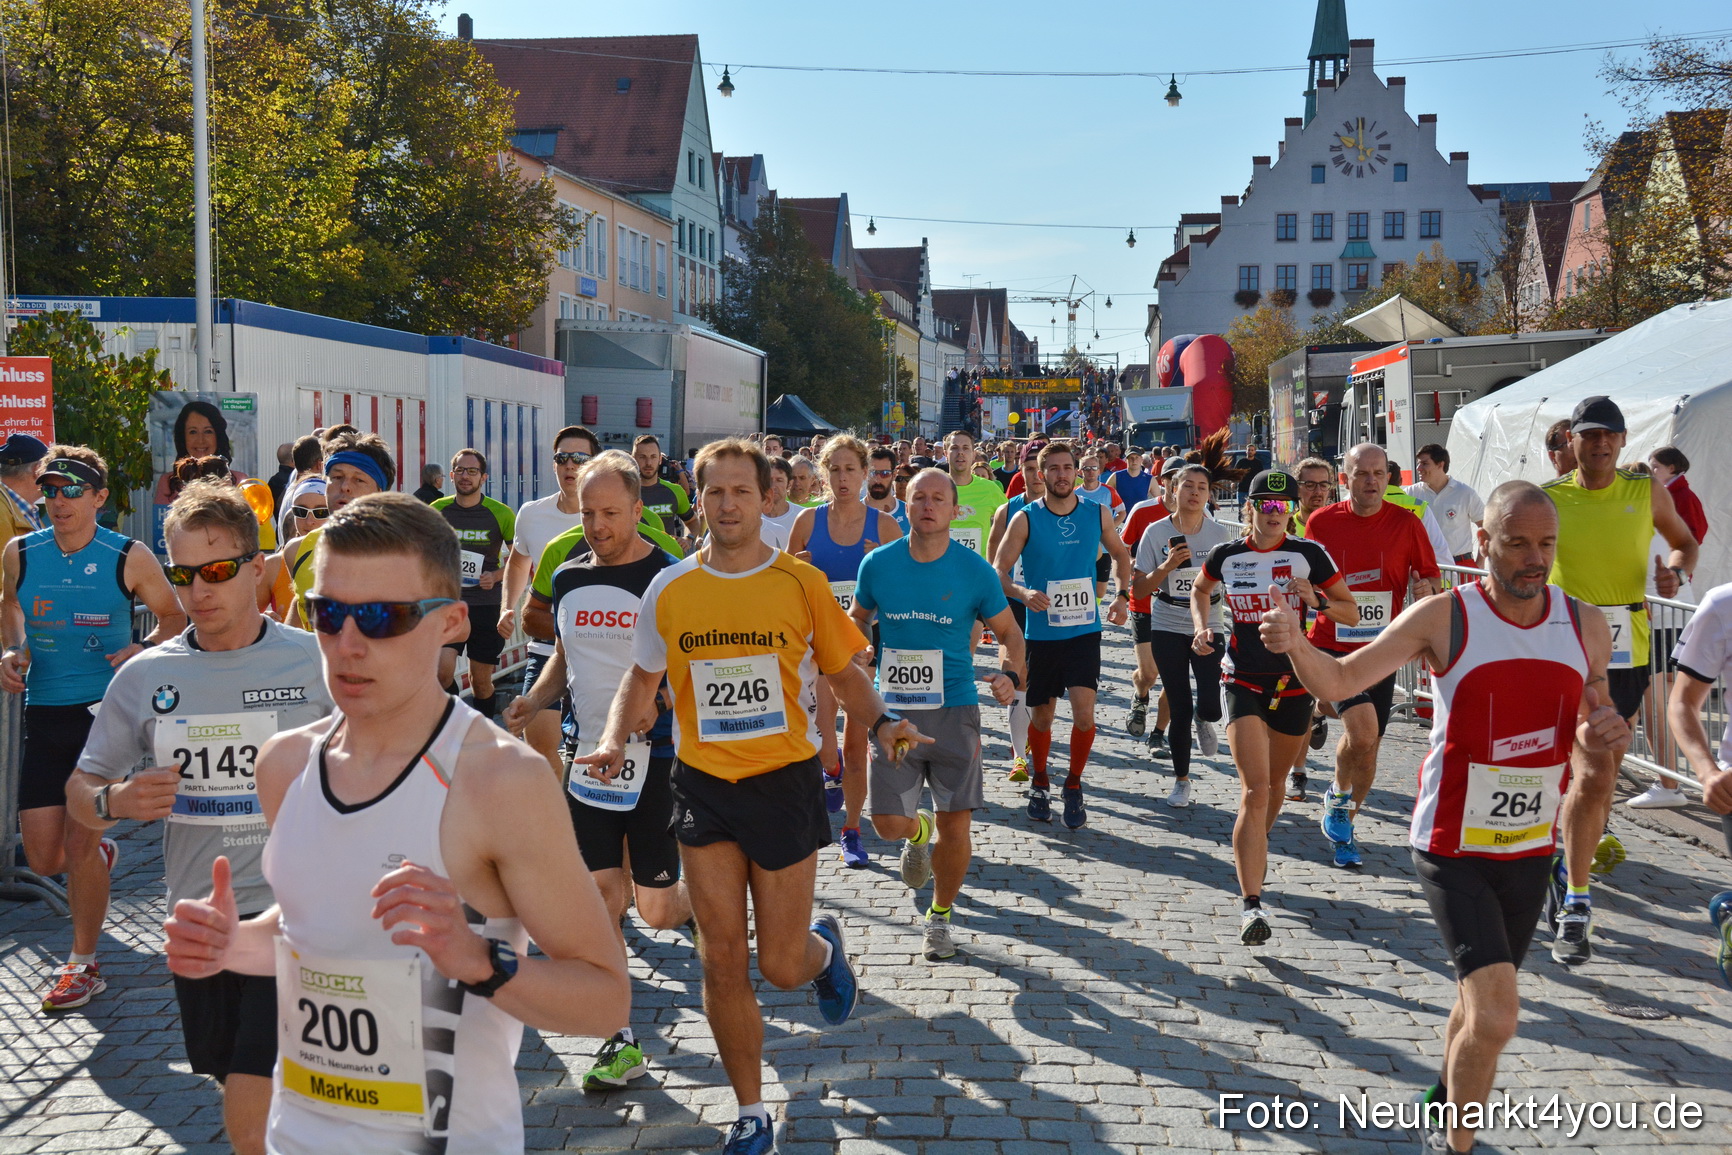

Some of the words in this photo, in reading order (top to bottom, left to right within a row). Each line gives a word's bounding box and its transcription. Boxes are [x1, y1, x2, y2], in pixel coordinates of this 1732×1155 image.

[32, 302, 46, 310] DIXI
[0, 366, 45, 383] hluss
[1013, 381, 1049, 391] START
[31, 416, 44, 427] für
[648, 503, 673, 514] CK
[454, 528, 491, 541] OCK
[955, 539, 976, 550] 75
[460, 560, 476, 574] 28
[1175, 579, 1195, 591] 25
[1054, 591, 1089, 608] 2110
[885, 610, 953, 625] www.hasit.de
[575, 631, 605, 639] Technik
[606, 631, 620, 640] fürs
[678, 629, 774, 653] Continental
[714, 663, 754, 677] BOCK
[887, 665, 934, 685] 2609
[243, 687, 306, 704] BOCK
[706, 678, 770, 707] 2246
[896, 694, 927, 704] Stephan
[733, 707, 759, 716] Neumarkt
[188, 724, 242, 738] BOCK
[720, 718, 765, 732] Matthias
[1510, 737, 1540, 751] DEHN
[173, 745, 259, 780] 2143
[1498, 774, 1544, 786] BOCK
[184, 784, 207, 792] PARTL
[208, 783, 244, 792] Neumarkt
[584, 789, 623, 803] Joachim
[187, 799, 253, 816] Wolfgang
[1489, 791, 1543, 818] 264
[1485, 819, 1507, 827] PARTL
[1494, 831, 1529, 845] Rainer
[300, 967, 366, 994] BOCK
[298, 998, 379, 1056] 200
[300, 1051, 327, 1067] PARTL
[328, 1058, 375, 1074] Neumarkt
[310, 1075, 379, 1106] Markus
